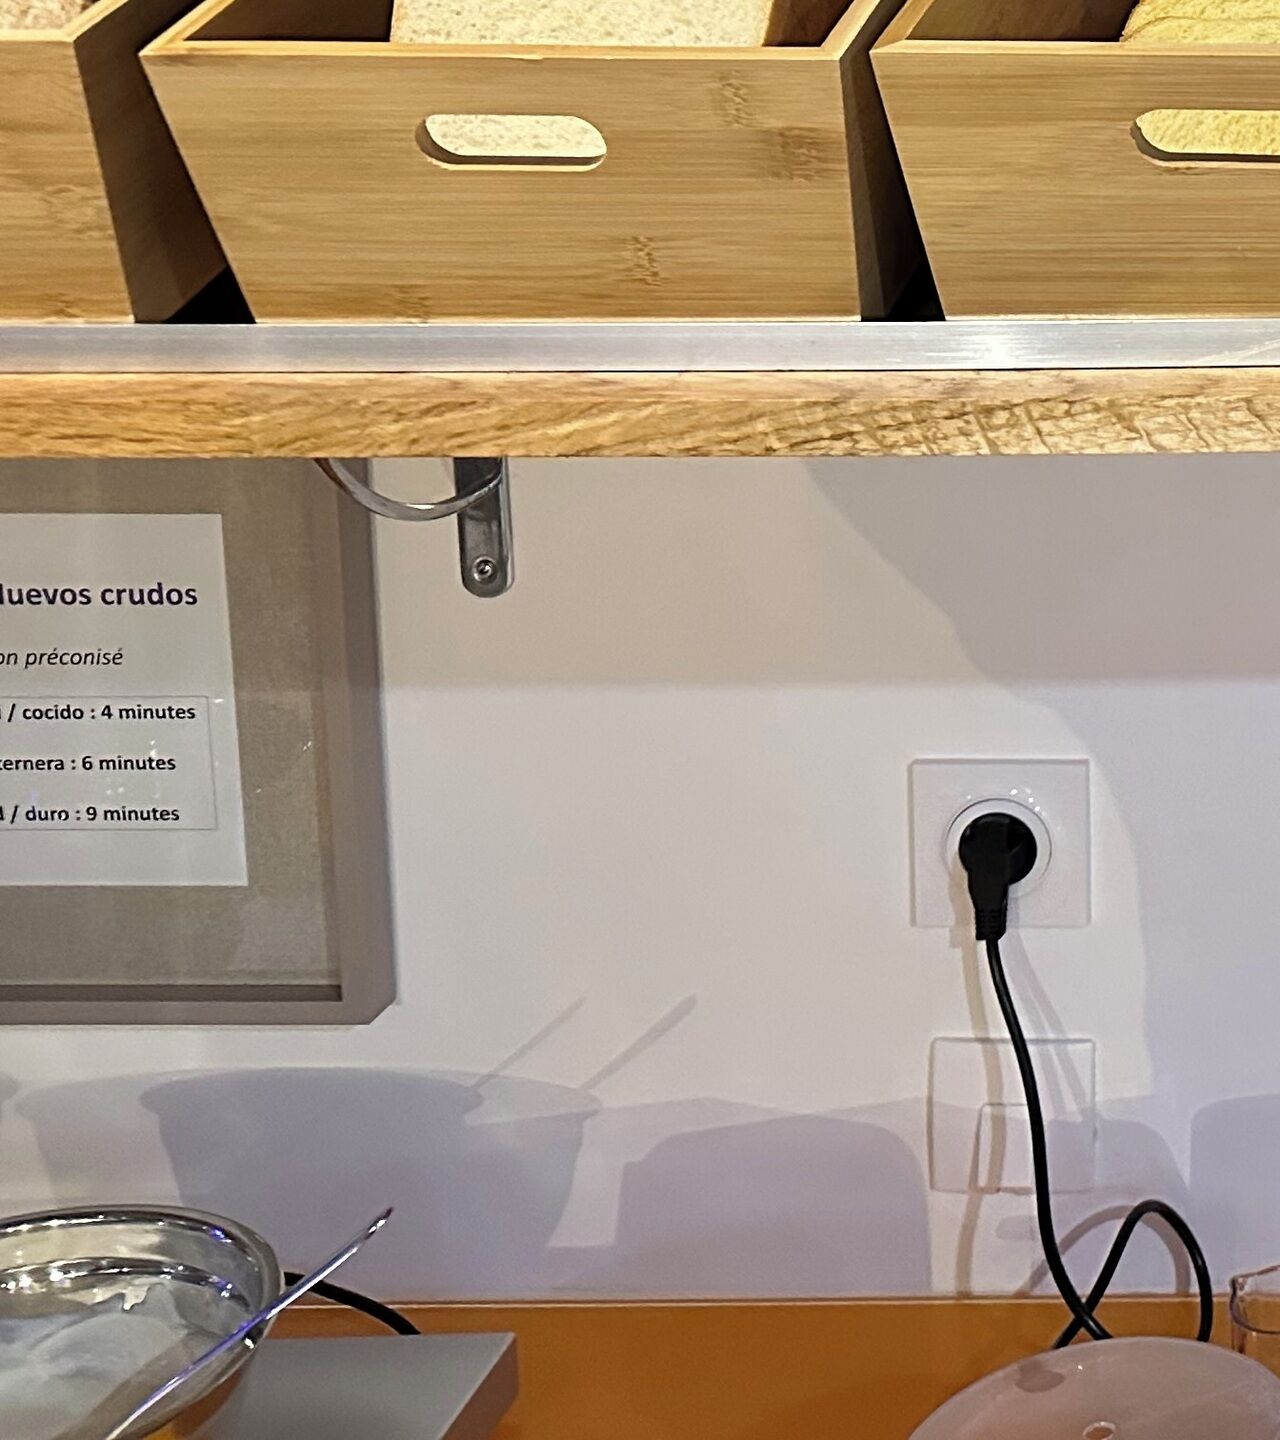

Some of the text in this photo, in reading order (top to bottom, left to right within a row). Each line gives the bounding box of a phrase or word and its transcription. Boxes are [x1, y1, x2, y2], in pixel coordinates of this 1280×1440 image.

[99, 581, 199, 606] crudos
[24, 647, 124, 669] préconisé
[22, 704, 85, 721] cocido
[101, 704, 113, 721] 4
[118, 703, 197, 721] minutes
[80, 755, 94, 772] 6
[99, 755, 177, 772] minutes
[25, 805, 70, 823] duro
[86, 806, 98, 823] 9
[103, 805, 181, 823] minutes
